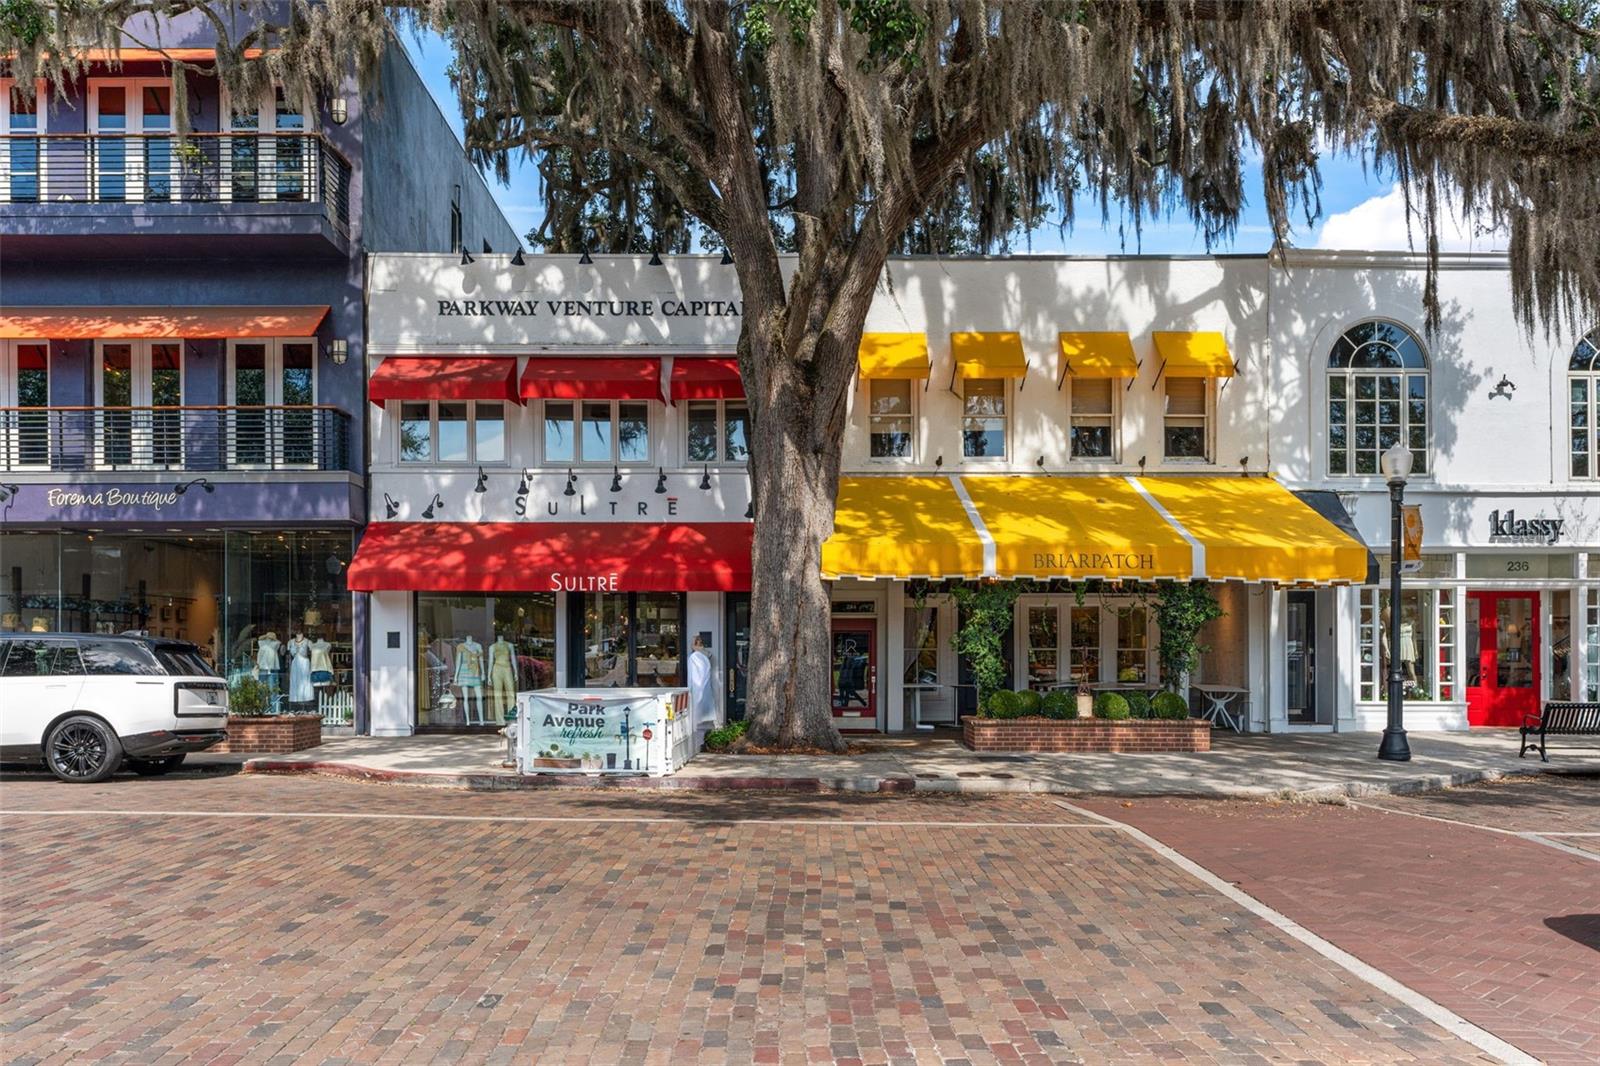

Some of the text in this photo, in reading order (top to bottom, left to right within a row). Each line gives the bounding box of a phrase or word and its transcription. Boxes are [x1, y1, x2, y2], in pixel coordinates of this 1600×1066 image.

[438, 300, 744, 317] PARKWAY VENTURE CAPITA
[47, 488, 177, 510] Forema Boutique
[1033, 553, 1154, 569] BRIARPATCH
[1507, 561, 1529, 572] 236
[567, 703, 606, 715] Park
[542, 714, 606, 728] Avenue
[560, 726, 604, 745] refresh
